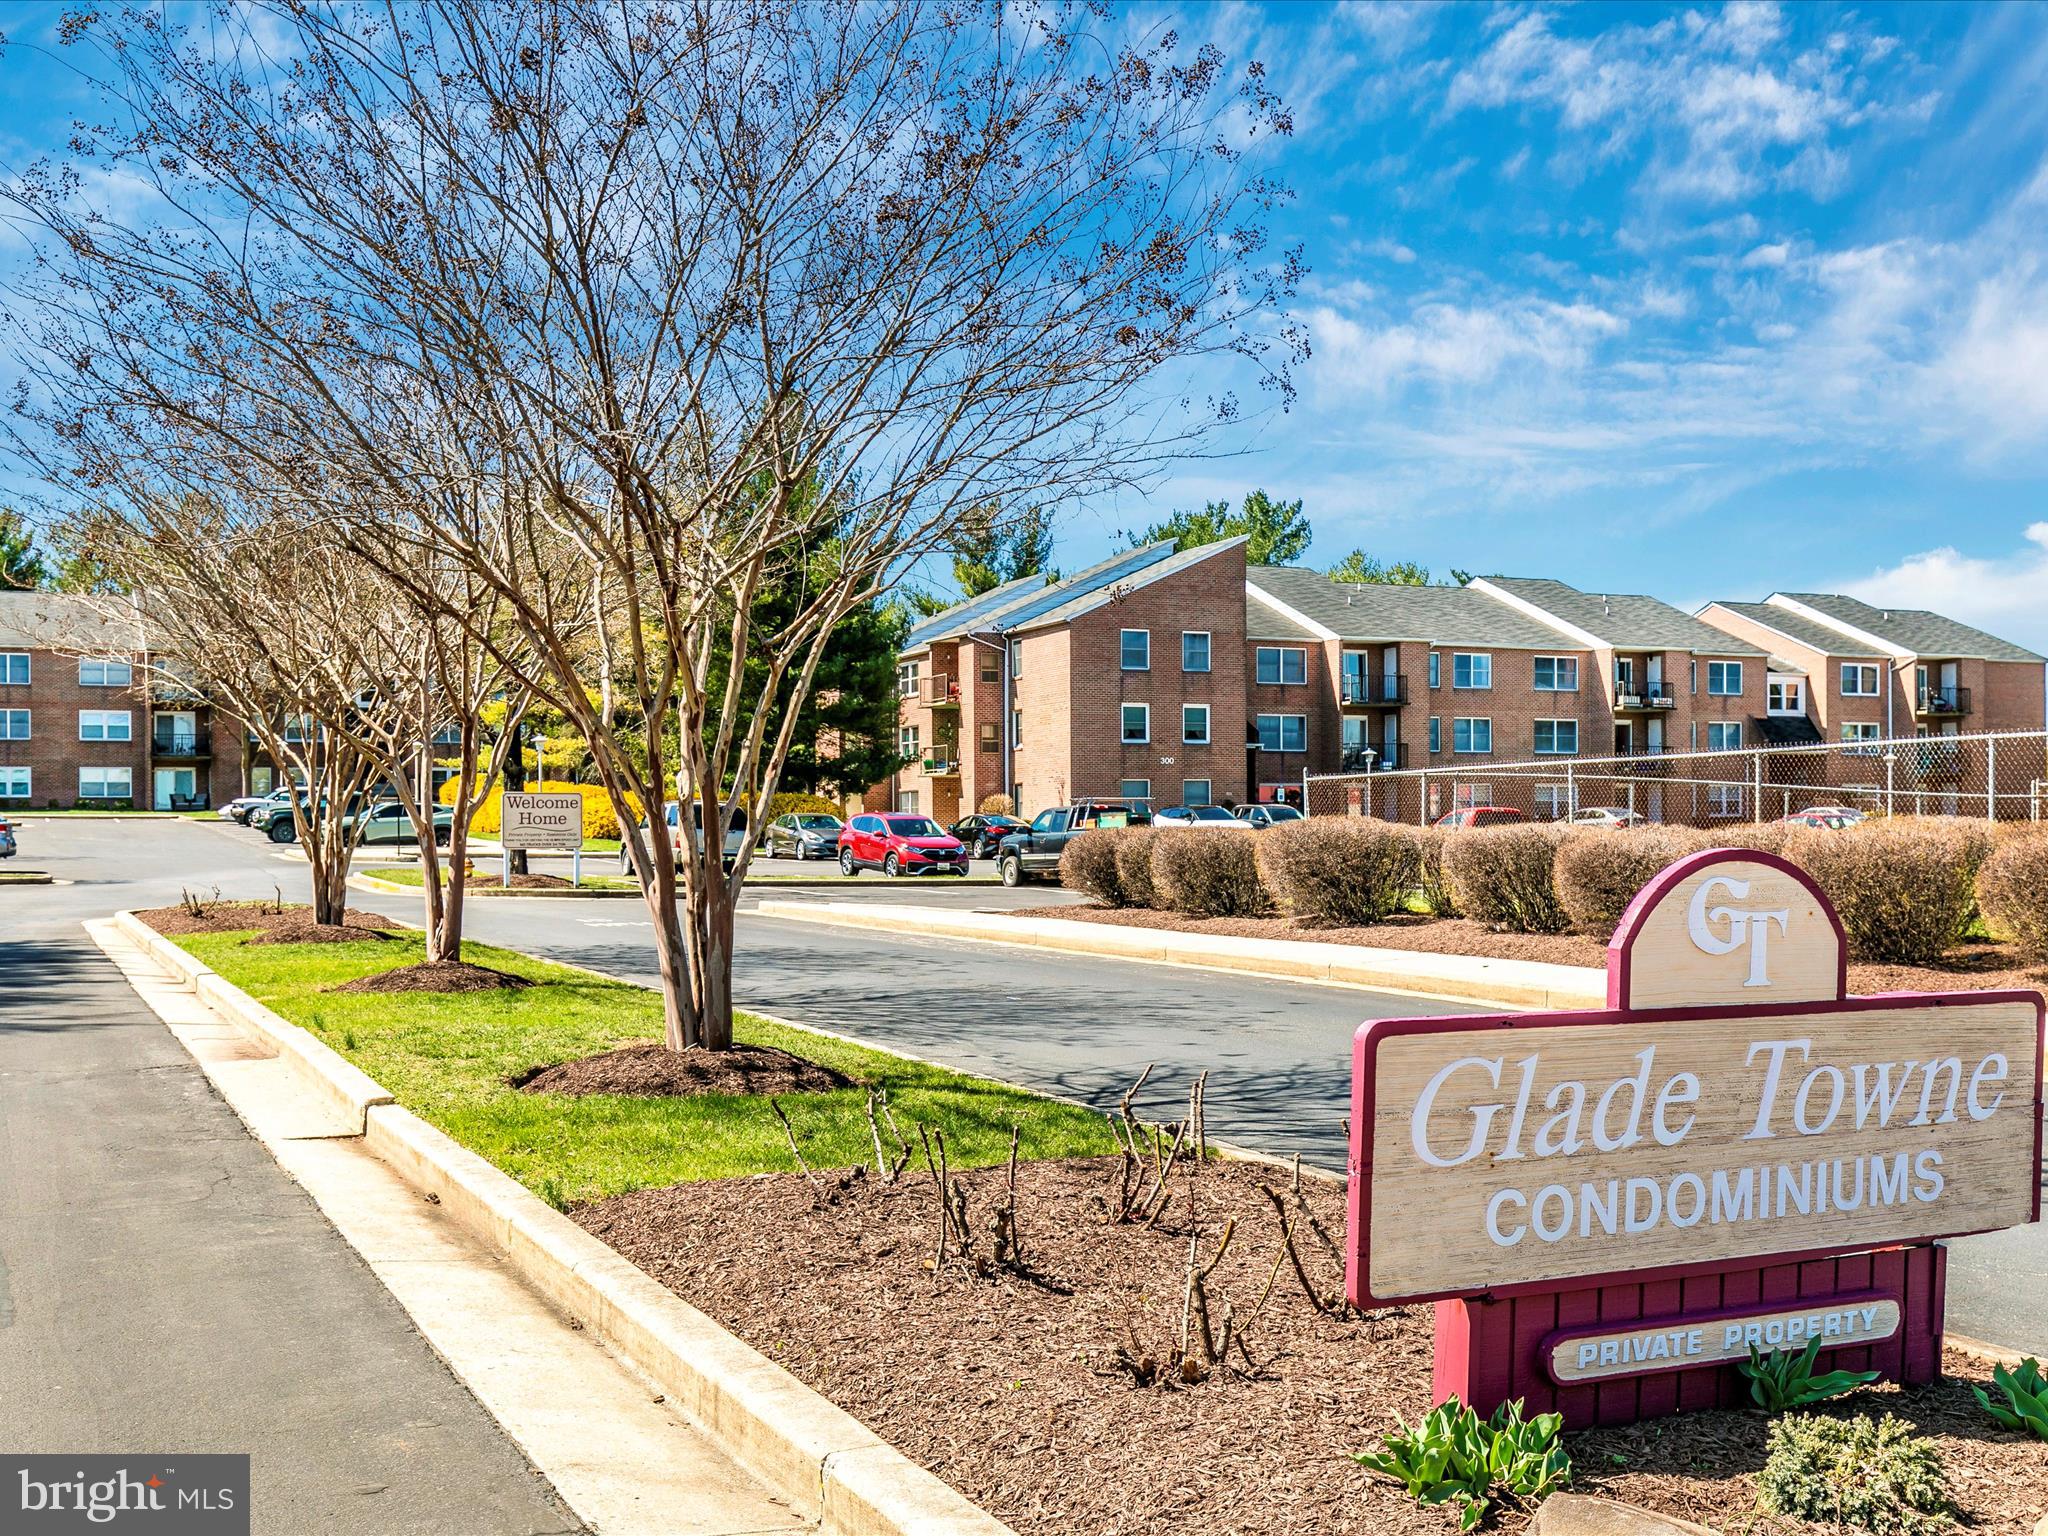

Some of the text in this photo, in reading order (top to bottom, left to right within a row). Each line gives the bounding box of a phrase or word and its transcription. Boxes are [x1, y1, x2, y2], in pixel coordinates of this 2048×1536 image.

[1160, 757, 1174, 765] 300
[506, 795, 579, 809] Welcome
[518, 812, 567, 825] Home
[1688, 876, 1789, 988] GT
[1411, 1037, 2009, 1168] Glade Towne
[1486, 1149, 1945, 1248] CONDOMINIUMS
[1578, 1306, 1878, 1370] PRIVATE PROPERTY
